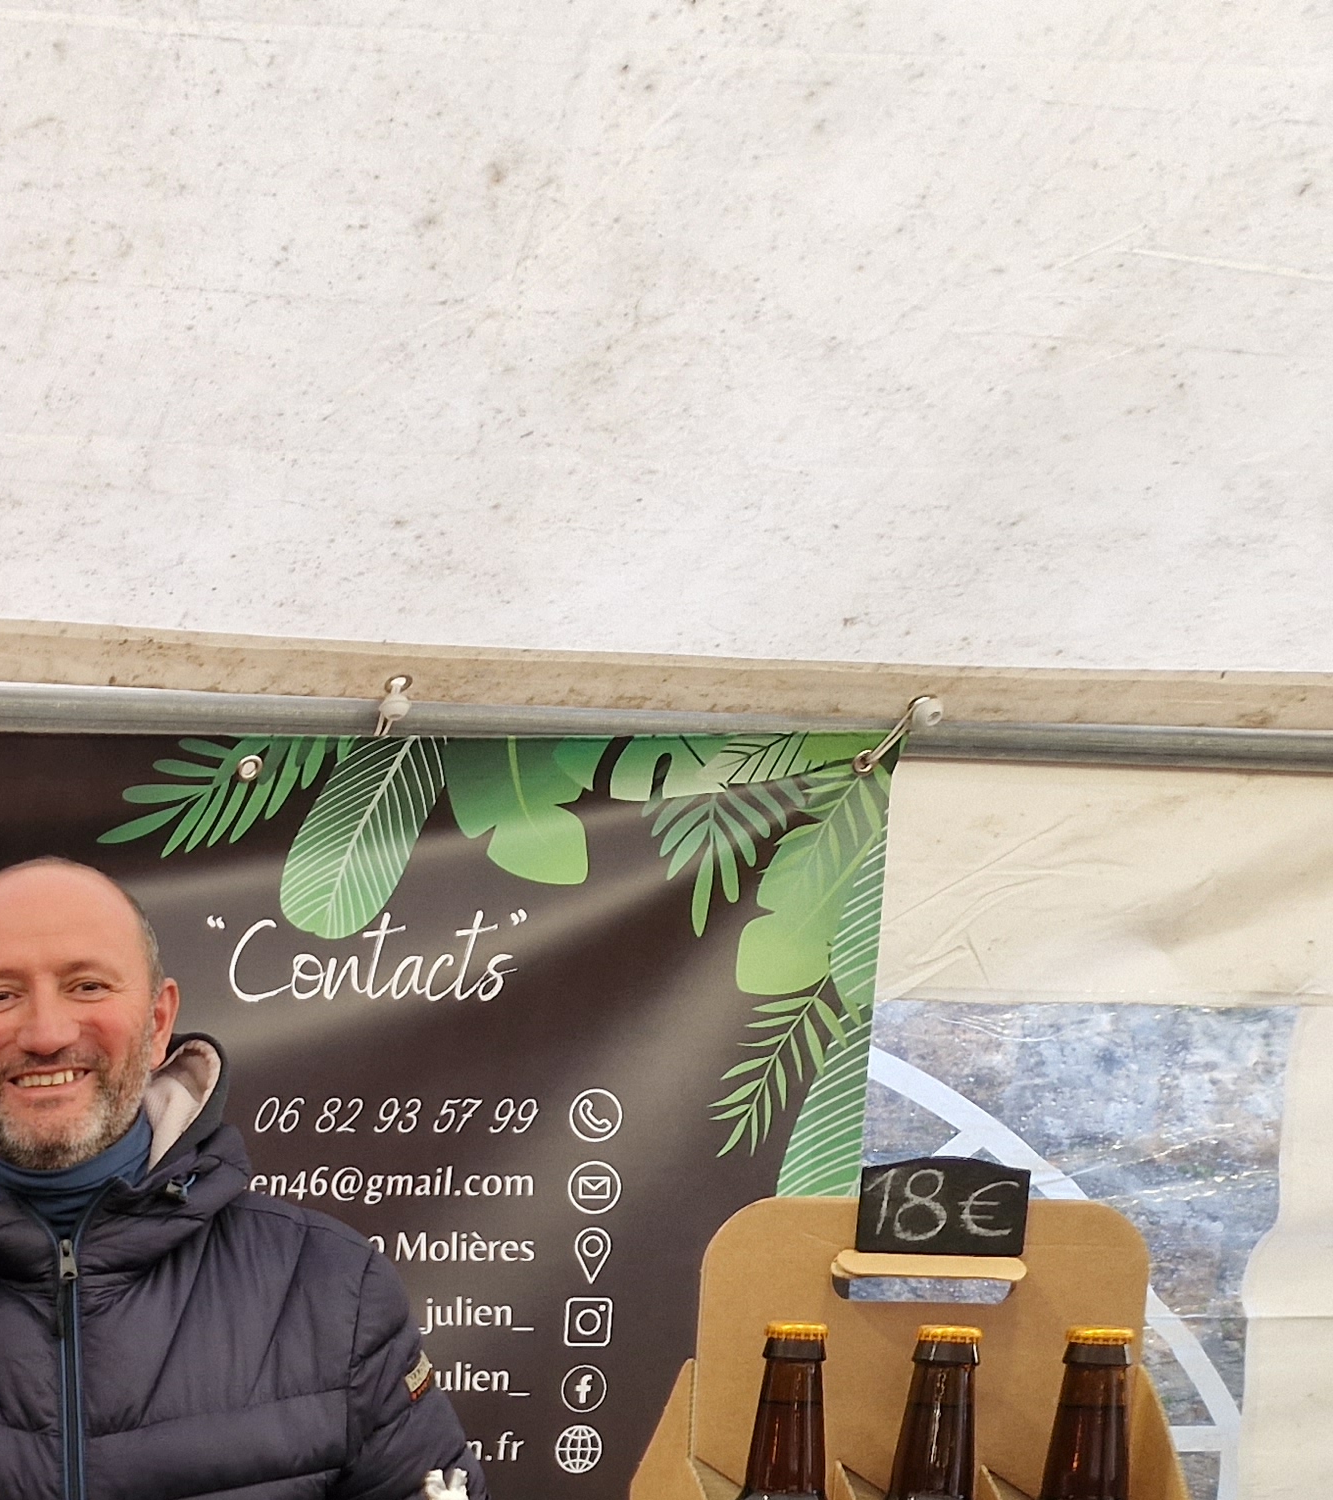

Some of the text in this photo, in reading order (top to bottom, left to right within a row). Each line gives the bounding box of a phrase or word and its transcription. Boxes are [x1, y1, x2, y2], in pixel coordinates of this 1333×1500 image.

[254, 1096, 539, 1134] 06 82 93 57 99
[394, 1231, 536, 1263] Molières
